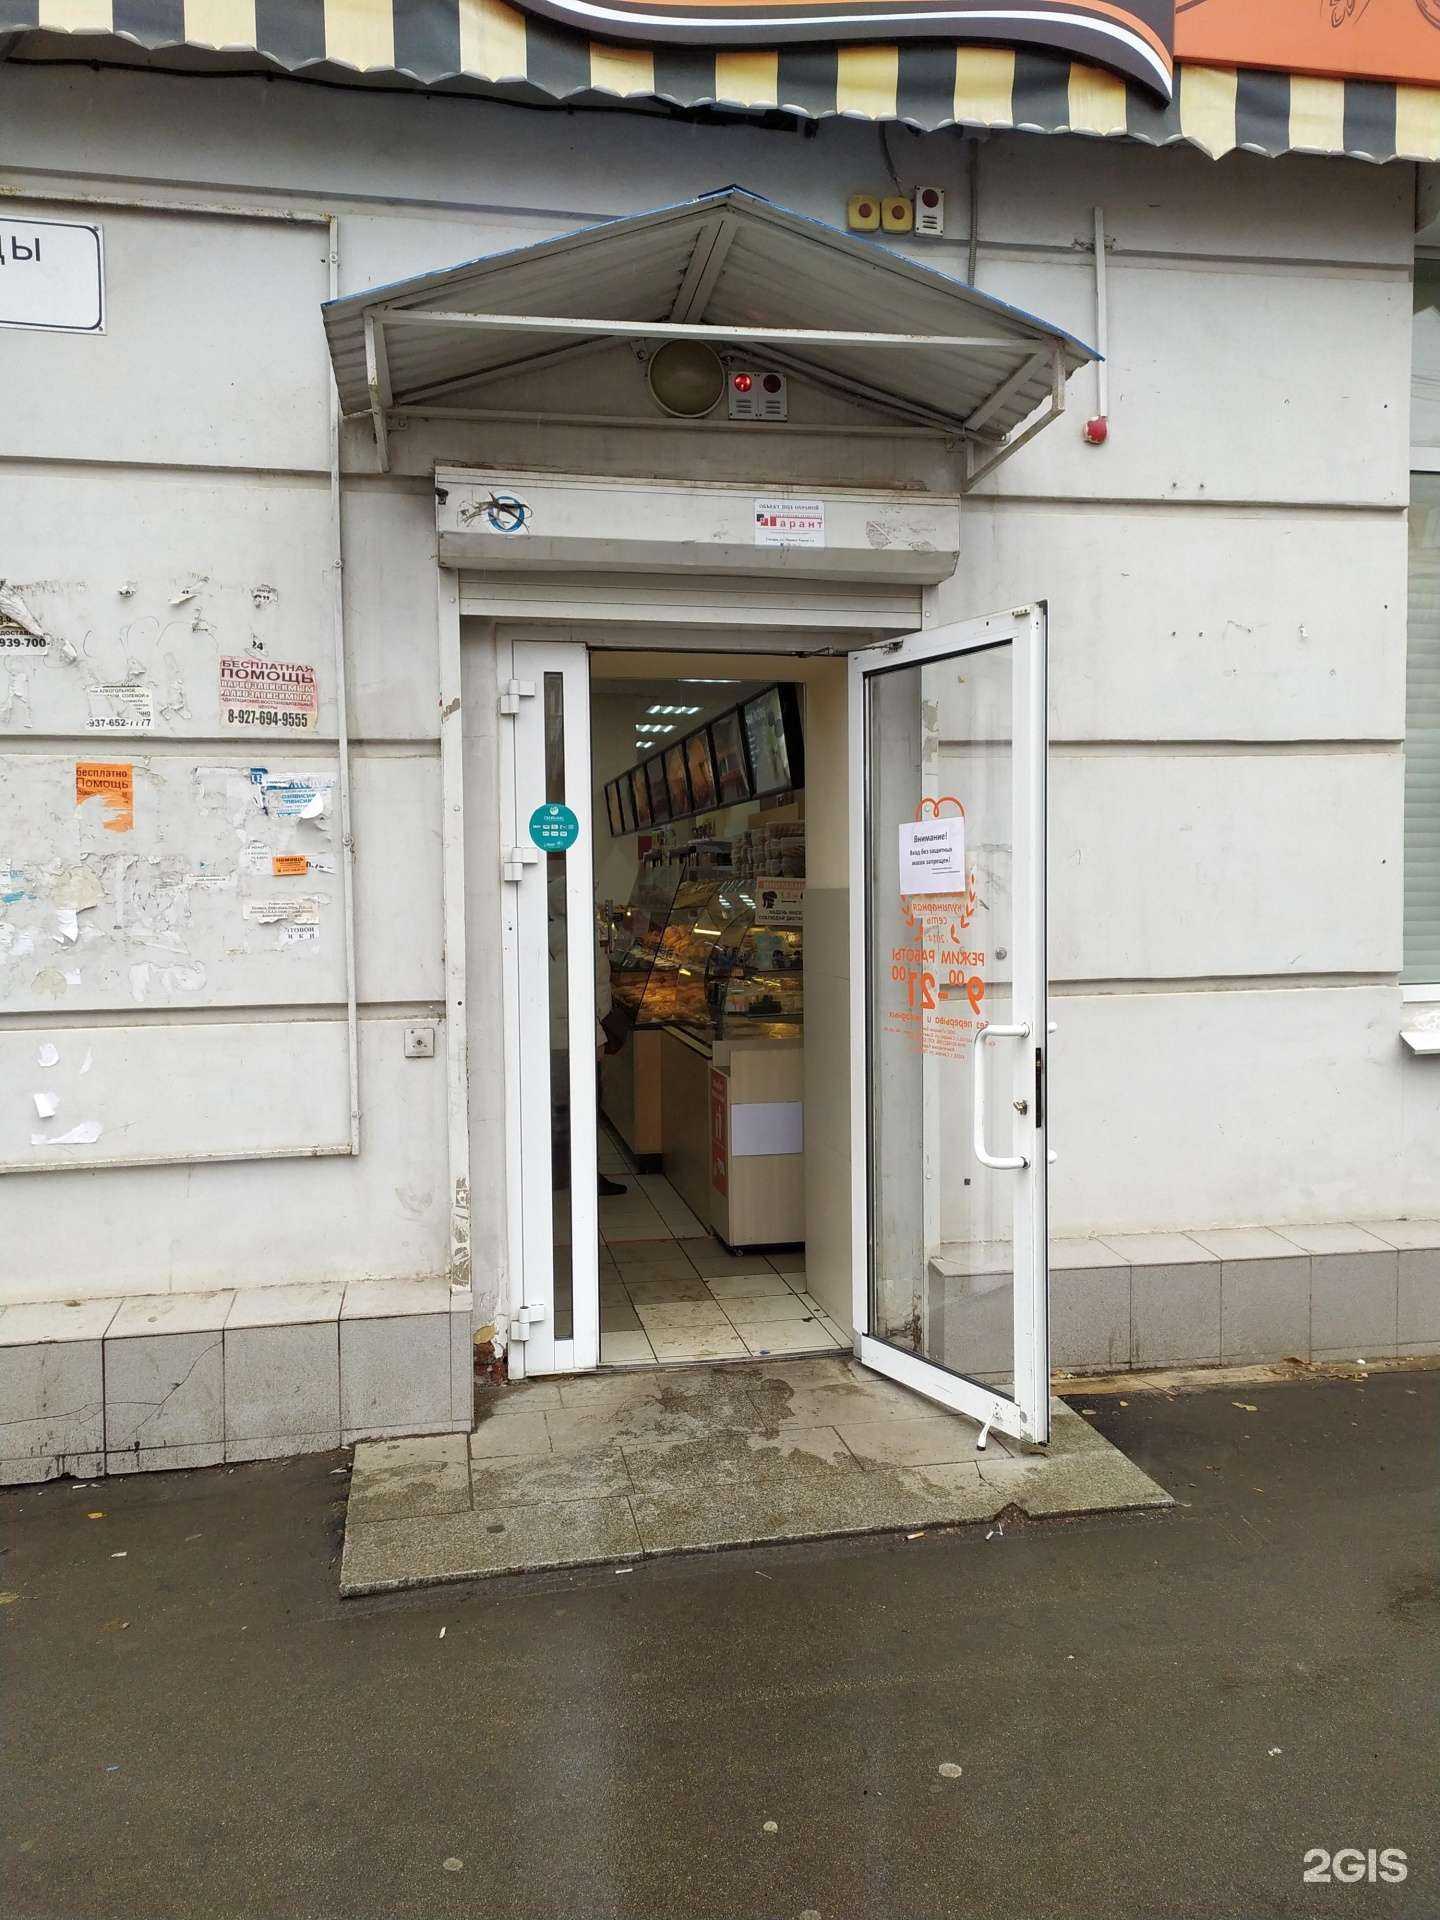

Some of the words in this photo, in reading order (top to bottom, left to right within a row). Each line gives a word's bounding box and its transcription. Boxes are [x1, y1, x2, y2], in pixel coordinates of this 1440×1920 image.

[222, 660, 314, 673] БЕСПЛАТНАЯ
[221, 668, 314, 684] ПОМОЩЬ
[228, 708, 307, 727] 8-927-694-9555
[76, 777, 129, 790] Помощь
[913, 832, 948, 843] Внимание!
